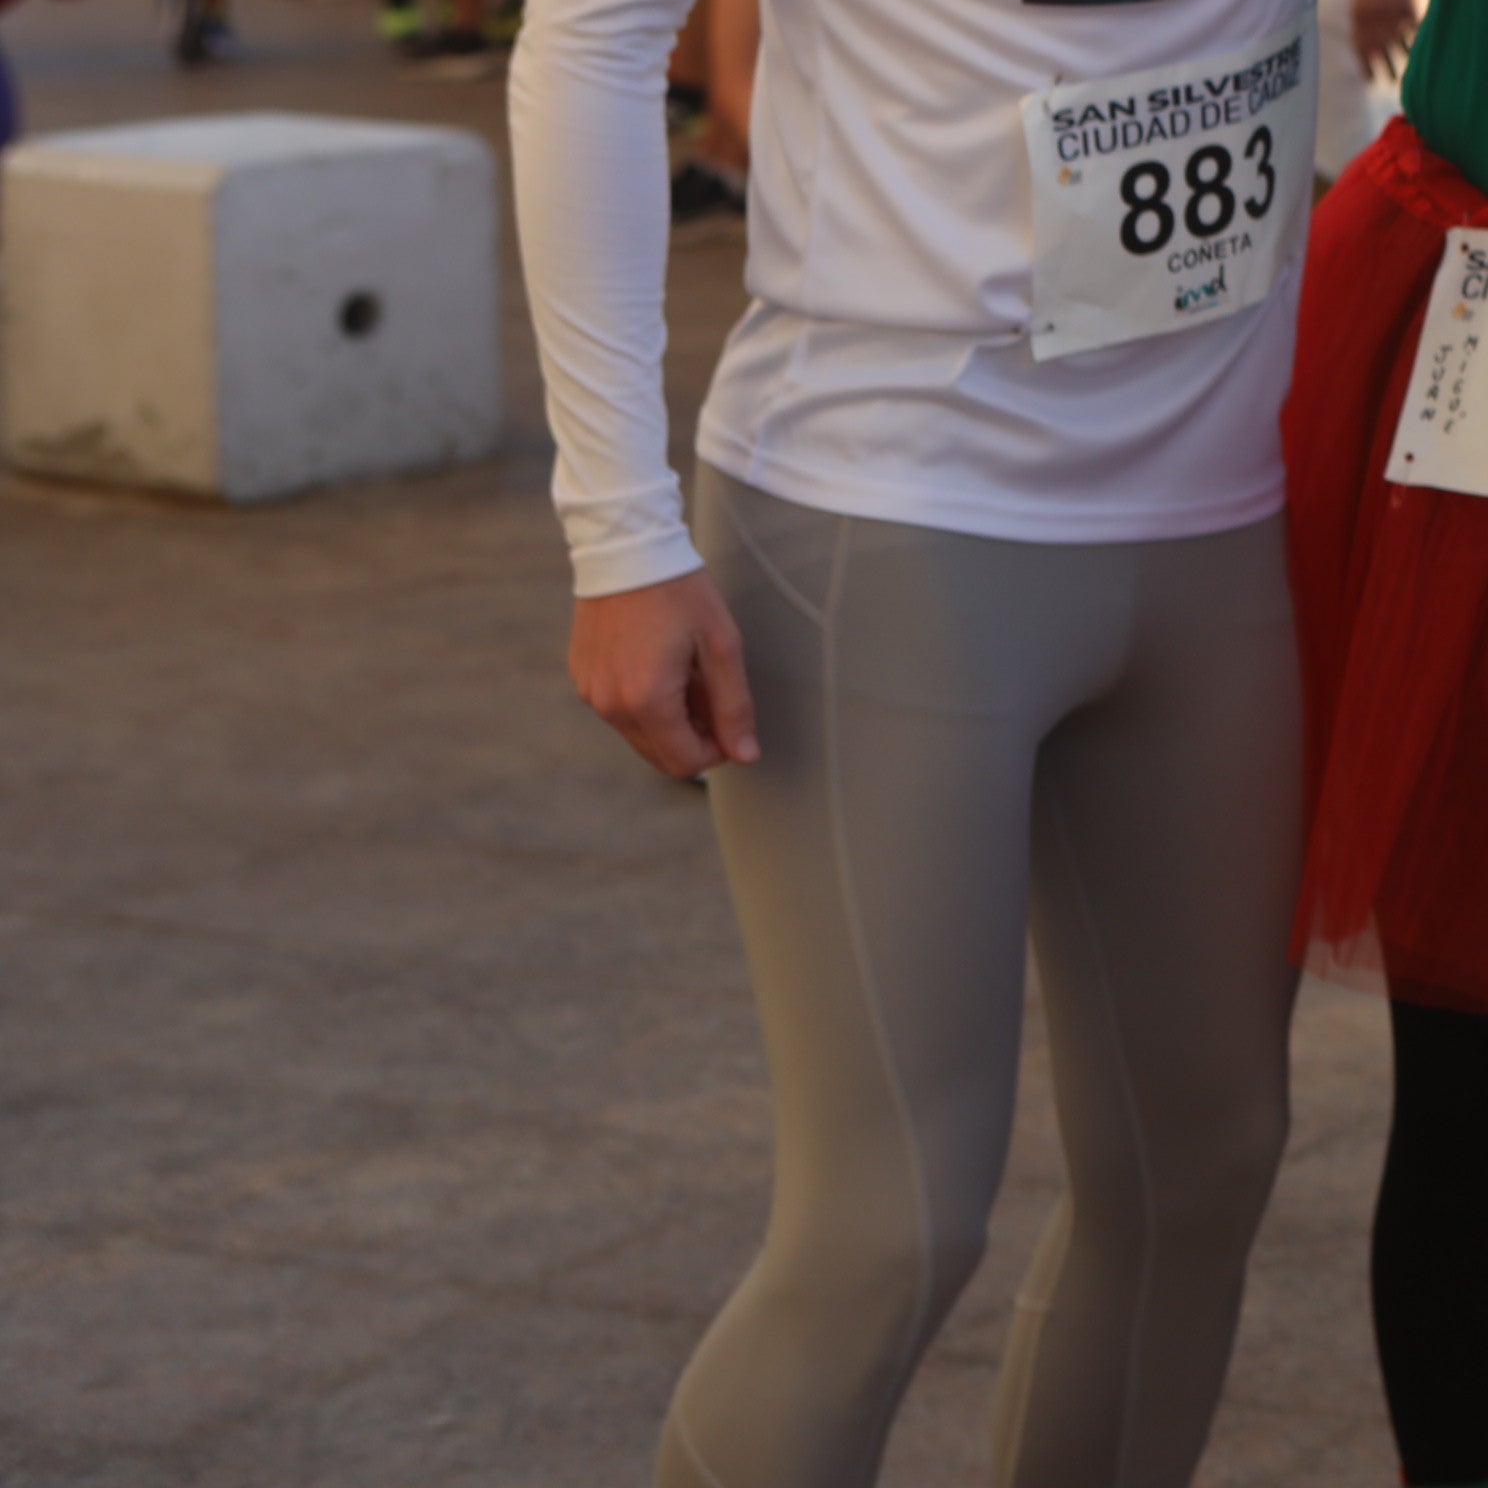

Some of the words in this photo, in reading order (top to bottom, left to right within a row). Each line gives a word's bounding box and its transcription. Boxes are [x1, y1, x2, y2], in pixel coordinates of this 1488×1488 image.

[1053, 96, 1136, 133] SAN
[1149, 35, 1302, 112] SILVESTRE
[1057, 110, 1191, 162] CIUDAD
[1201, 95, 1243, 131] DE
[1119, 124, 1276, 256] 883
